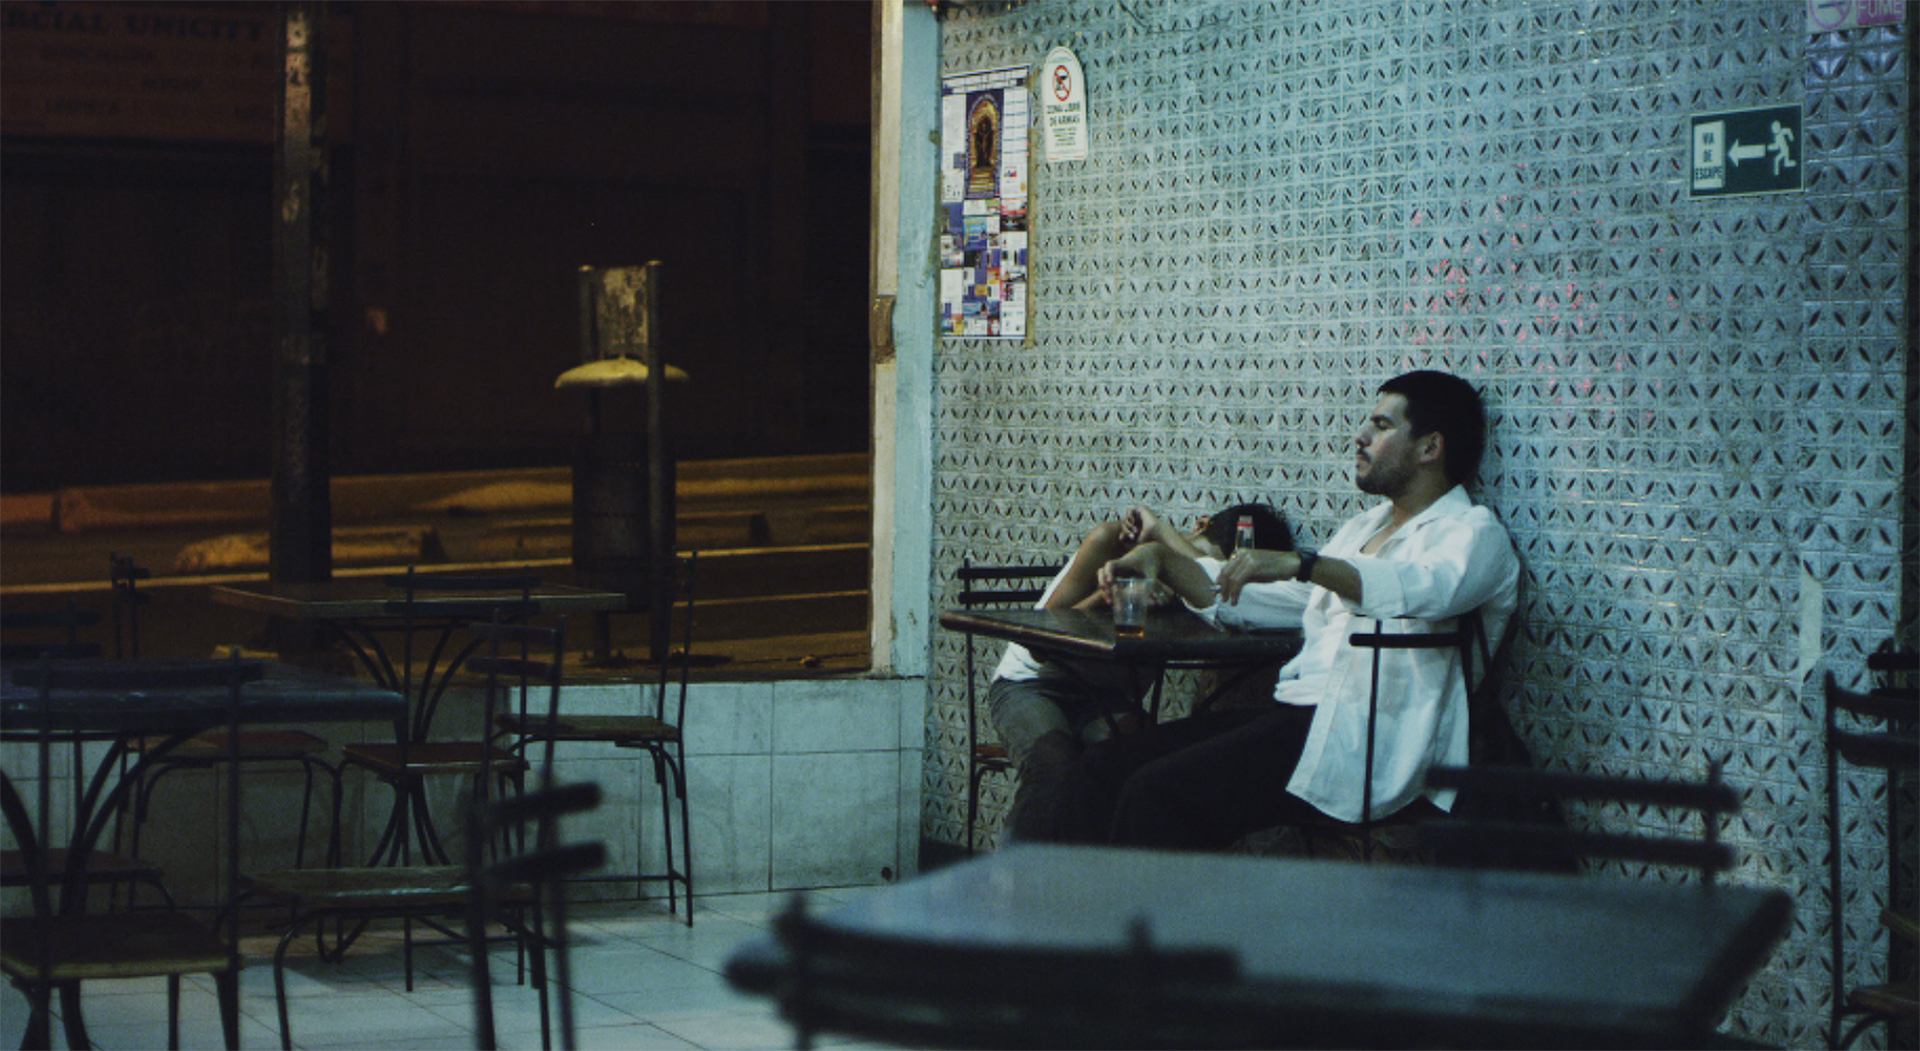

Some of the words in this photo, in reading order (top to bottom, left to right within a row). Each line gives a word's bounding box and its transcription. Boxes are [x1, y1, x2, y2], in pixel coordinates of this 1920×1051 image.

[1049, 115, 1057, 127] DE
[1704, 149, 1713, 162] DE
[1695, 166, 1722, 180] ESCAPE
